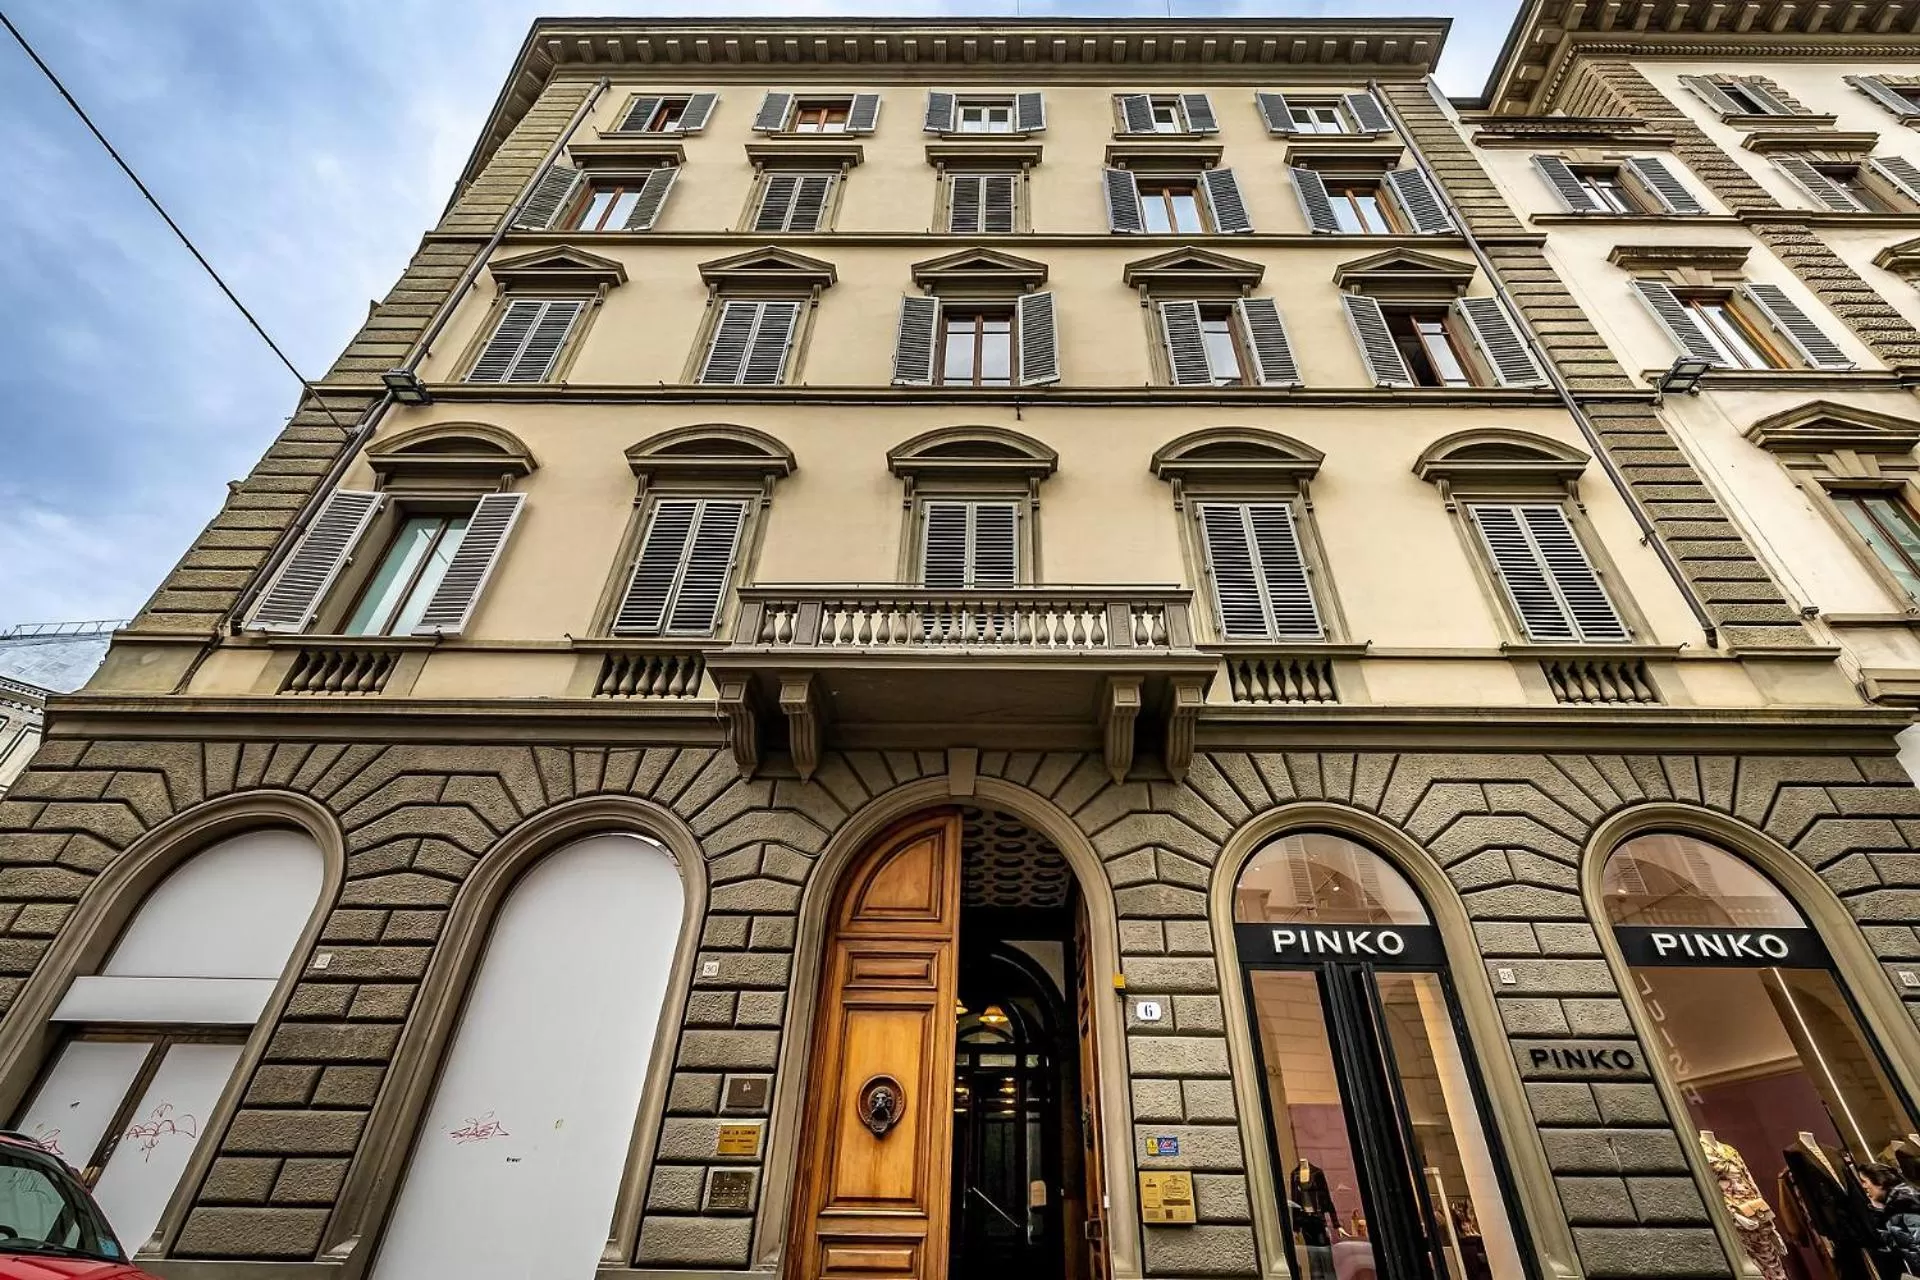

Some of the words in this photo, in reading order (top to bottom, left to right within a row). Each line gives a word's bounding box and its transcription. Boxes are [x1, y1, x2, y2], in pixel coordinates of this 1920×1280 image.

[1272, 929, 1405, 956] PINKO
[1651, 932, 1789, 959] PINKO
[1144, 1003, 1154, 1018] 6
[1529, 1047, 1636, 1070] PINKO
